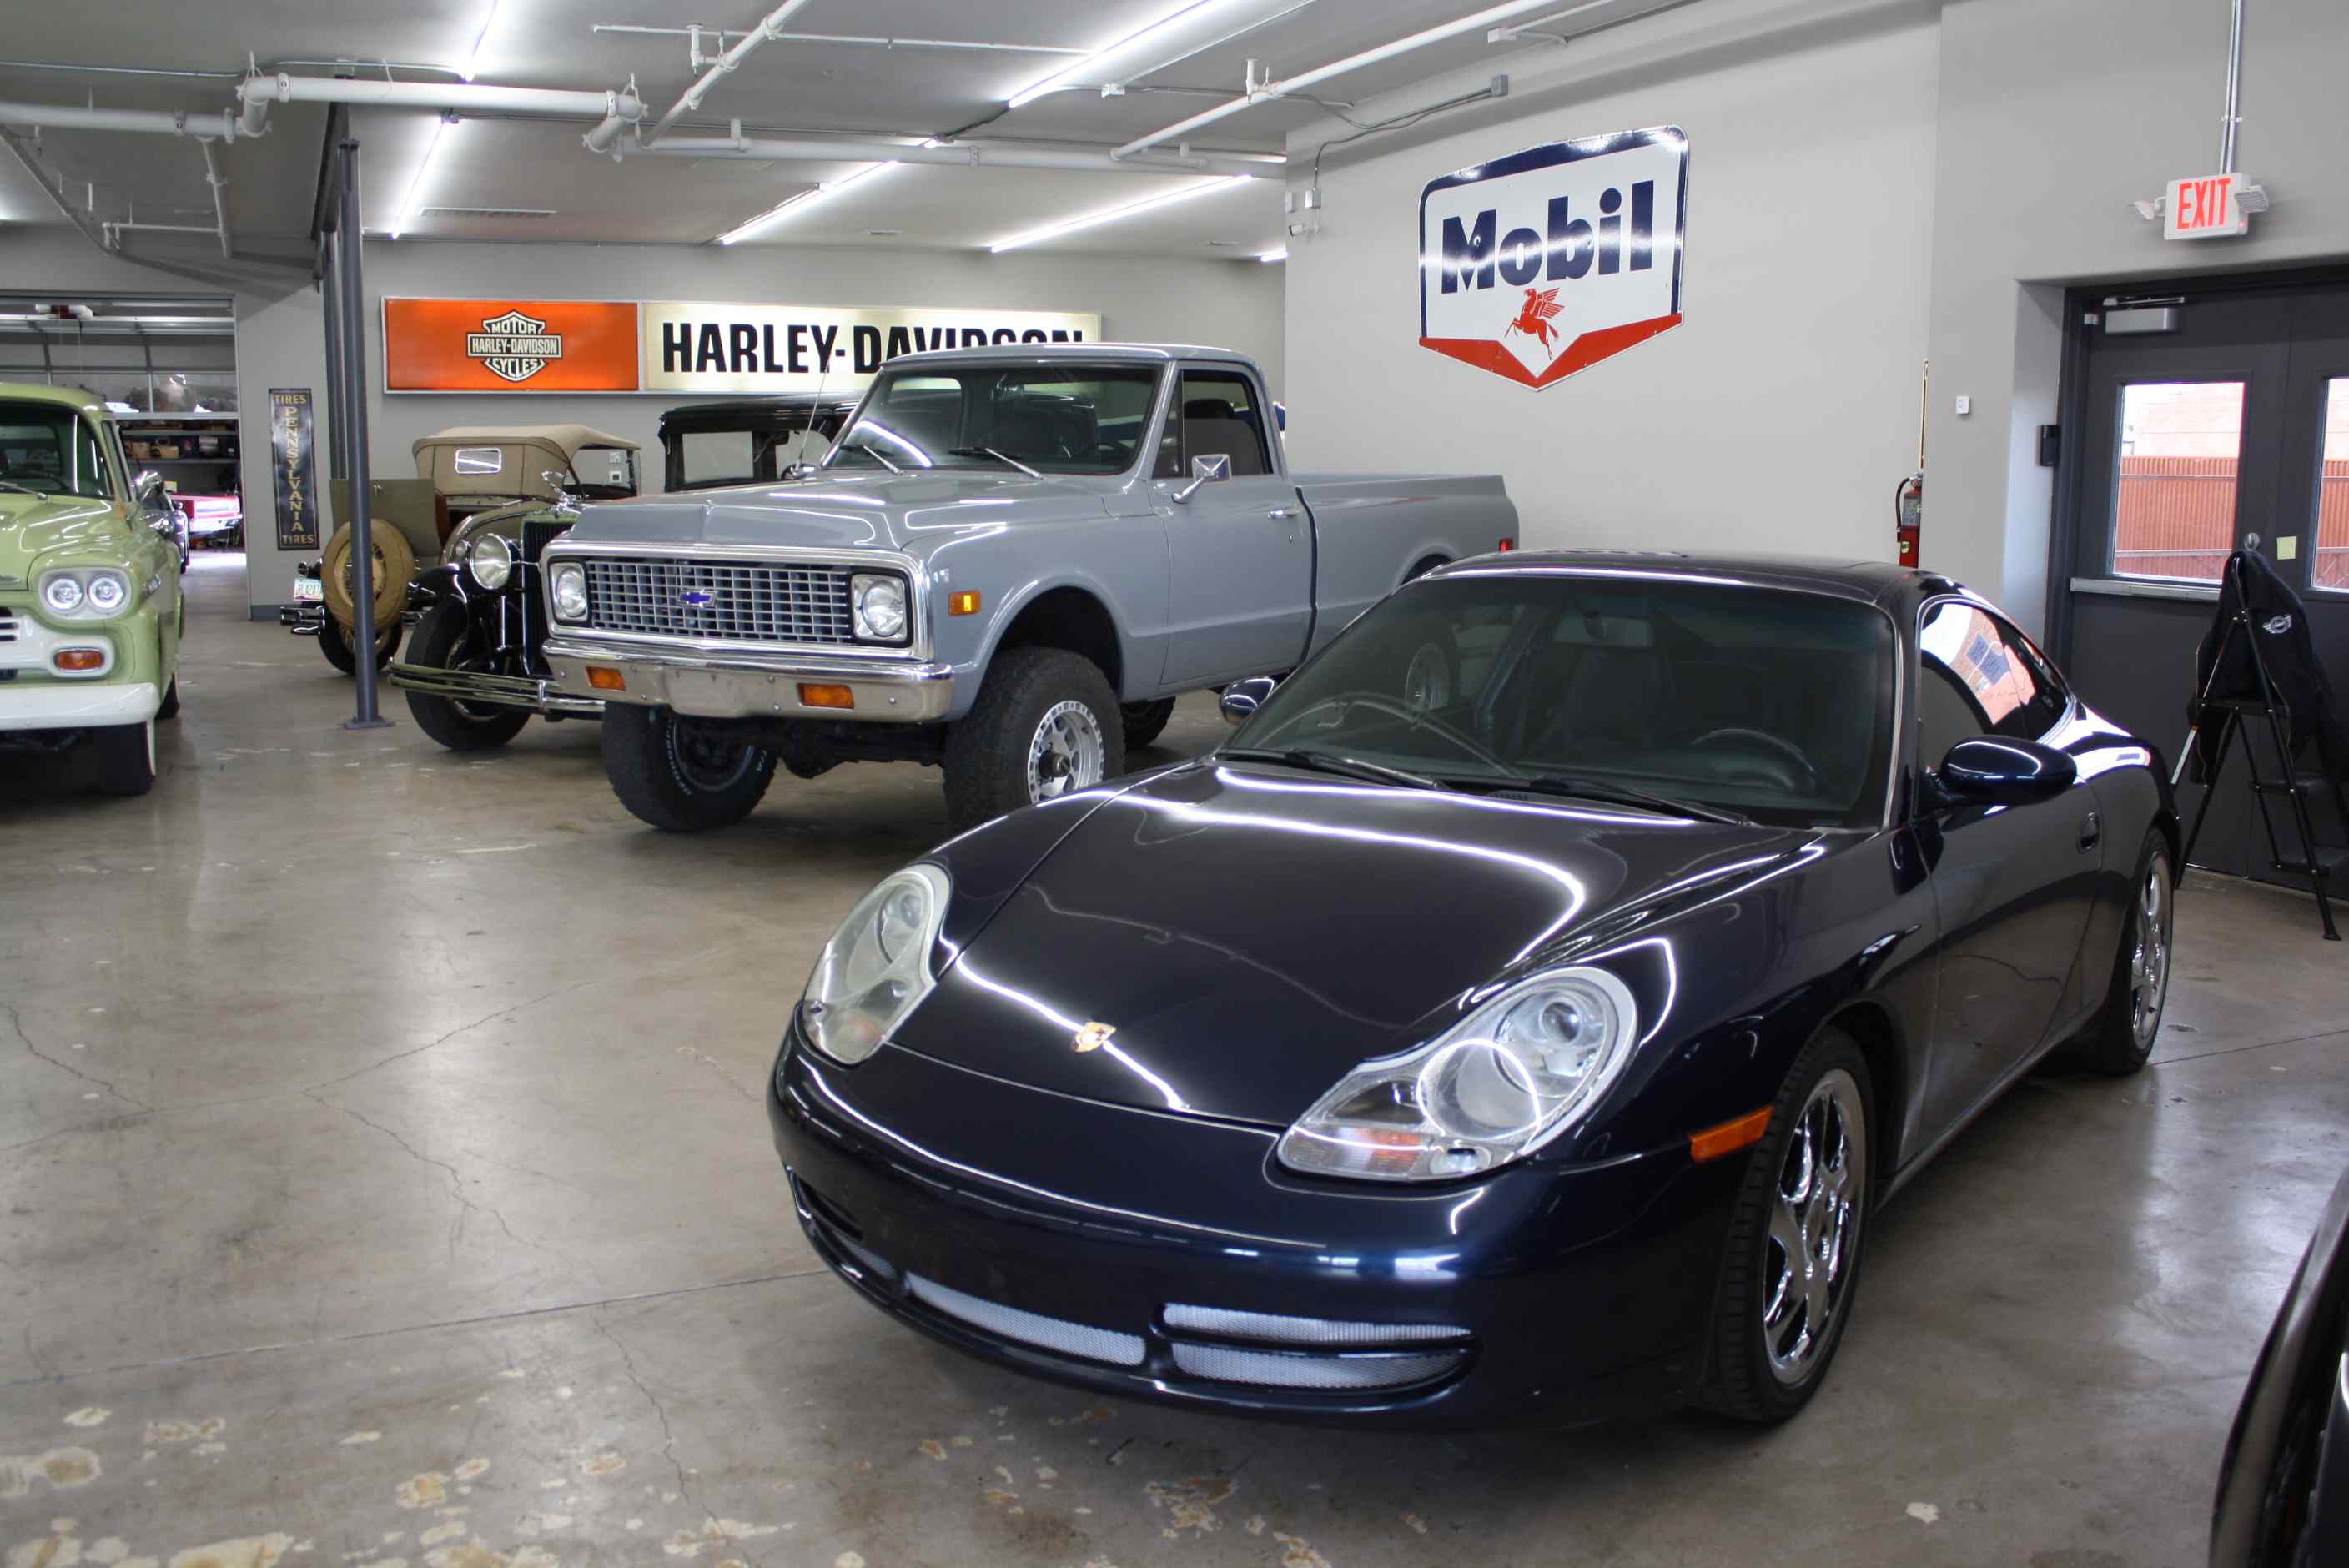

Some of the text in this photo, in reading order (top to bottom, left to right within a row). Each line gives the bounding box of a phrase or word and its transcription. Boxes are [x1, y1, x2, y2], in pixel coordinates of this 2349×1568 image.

[2175, 178, 2231, 230] EXIT
[1441, 180, 1654, 294] Mobil
[491, 317, 537, 334] MOTOR
[471, 337, 557, 354] HARLEY-DAVIDSON
[663, 322, 1083, 374] HARLEY-DAV
[492, 358, 538, 378] CYCLES
[273, 394, 308, 405] TIRES
[284, 406, 304, 532] PENNSYLVANIA
[281, 534, 315, 544] TIRES
